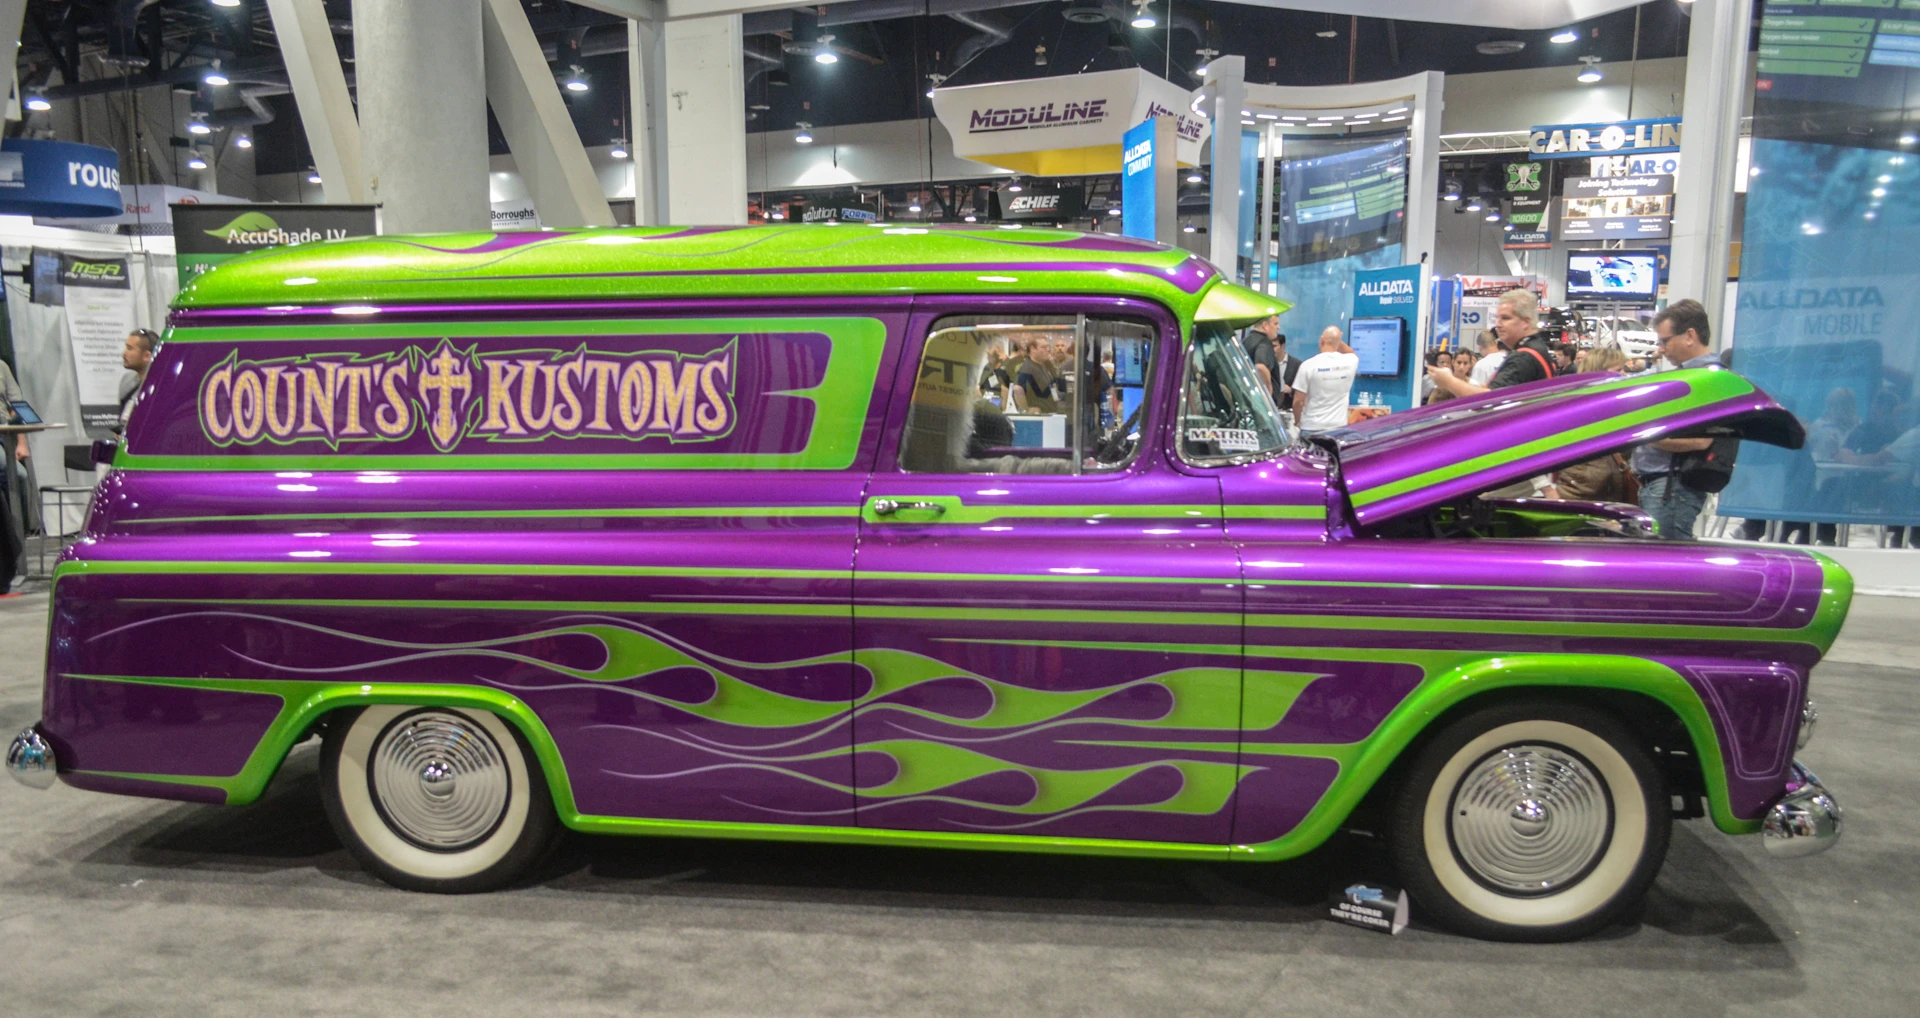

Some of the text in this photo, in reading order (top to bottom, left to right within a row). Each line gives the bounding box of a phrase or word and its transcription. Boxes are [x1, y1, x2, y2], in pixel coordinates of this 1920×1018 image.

[969, 99, 1107, 129] MODULINE
[68, 161, 120, 193] rous
[1578, 177, 1659, 188] Joining Technology
[1018, 195, 1060, 209] CHIEF
[490, 207, 535, 220] Borroughs
[1512, 214, 1538, 223] 10600
[226, 227, 322, 245] AccuShade
[71, 261, 121, 275] MSA
[1358, 279, 1414, 296] ALLDATA
[1739, 286, 1885, 310] ALLDATA
[1803, 312, 1883, 336] MOBILE
[204, 351, 734, 440] COUNT'S KUSTOMS
[1191, 430, 1256, 441] MATRIX
[1350, 904, 1383, 918] COURSE
